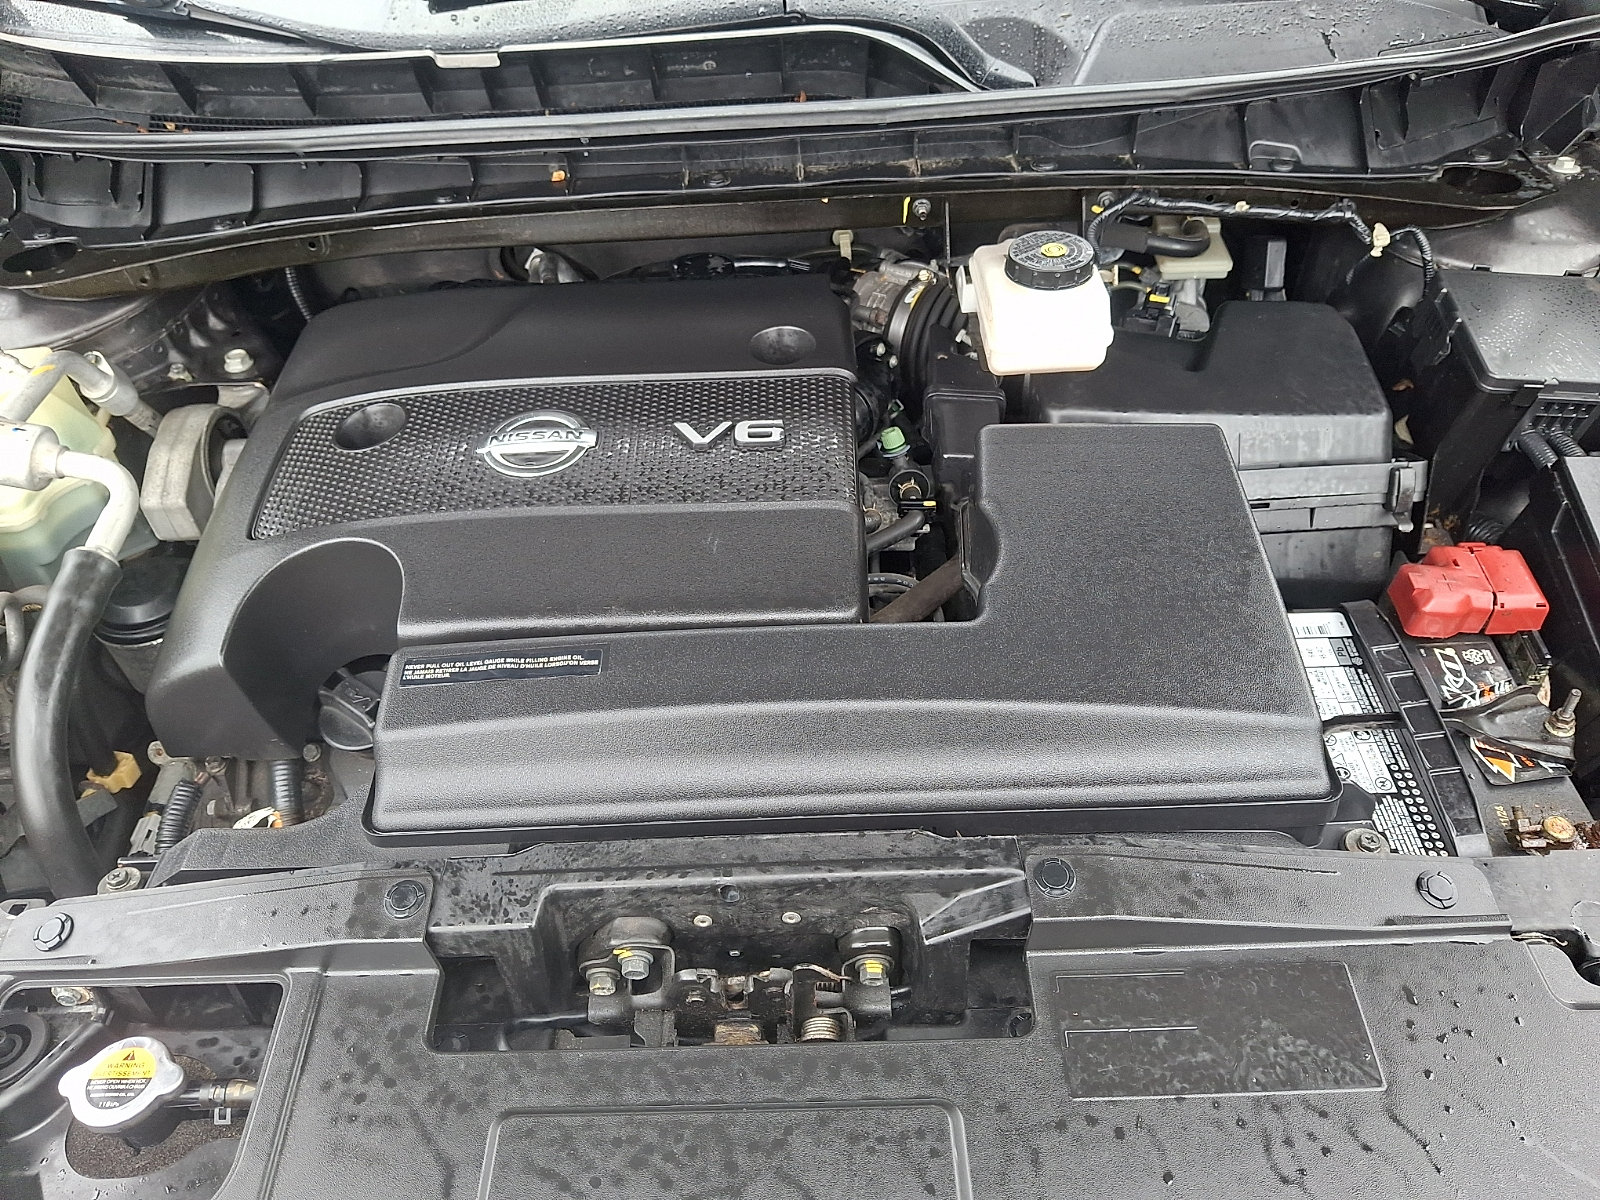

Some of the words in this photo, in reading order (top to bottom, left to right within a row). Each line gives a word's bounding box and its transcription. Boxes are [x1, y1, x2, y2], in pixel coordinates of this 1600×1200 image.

[489, 429, 584, 444] NISSAN
[673, 419, 785, 448] V6
[1336, 646, 1347, 657] Pb
